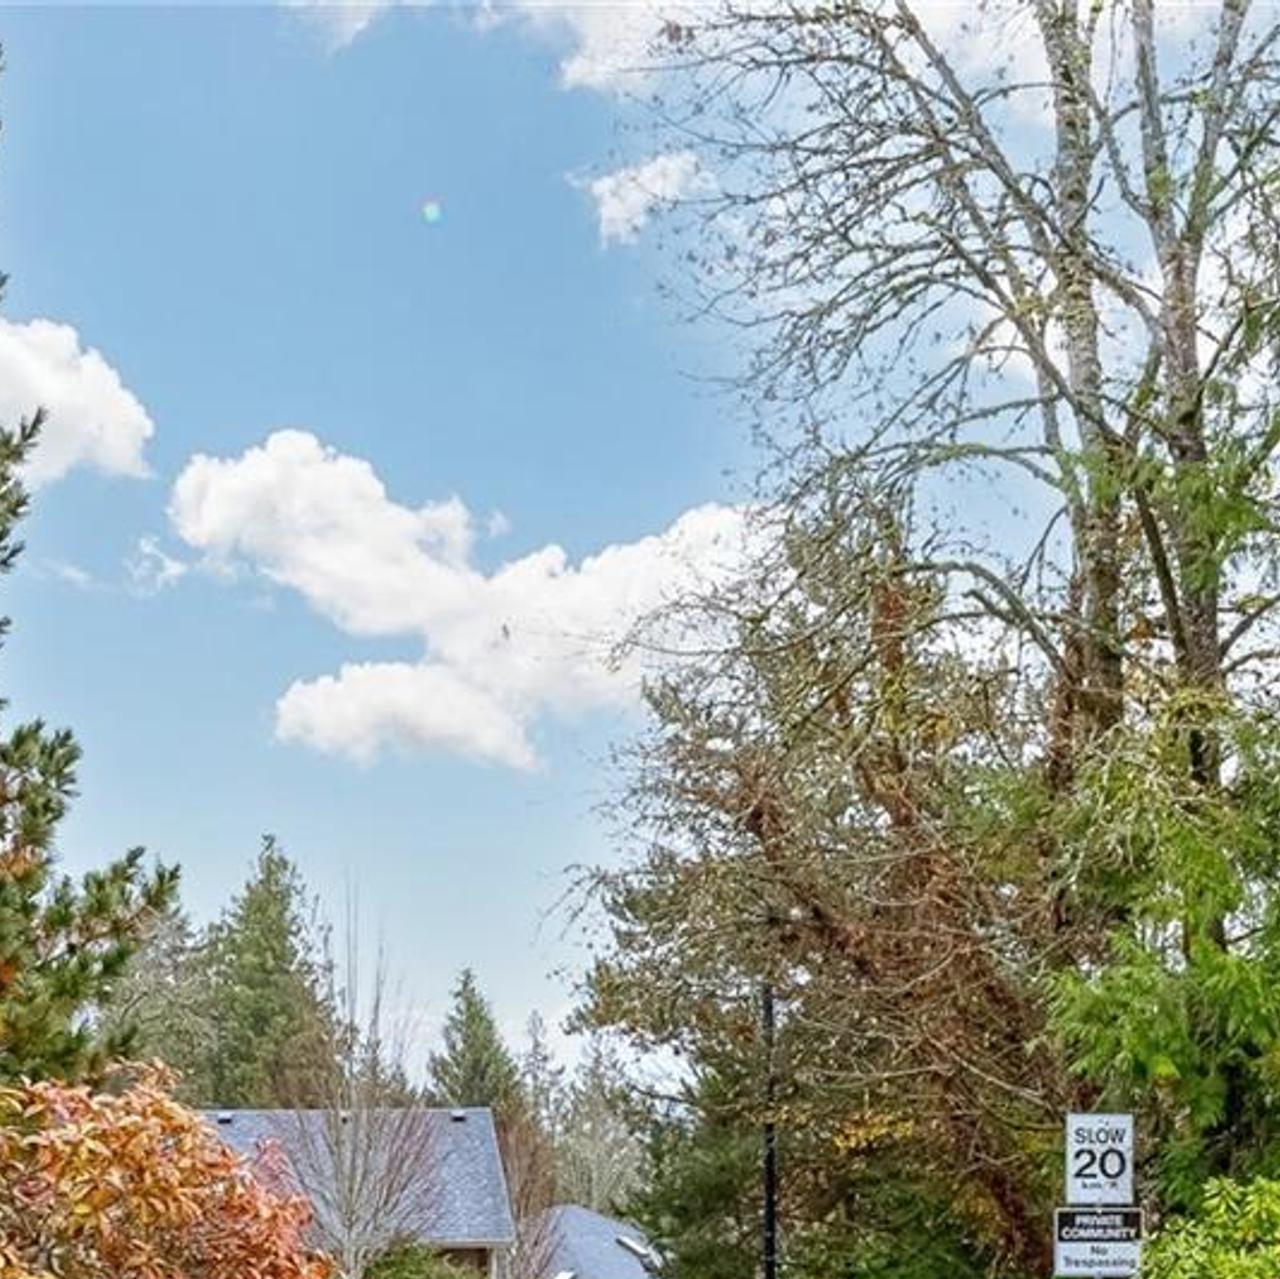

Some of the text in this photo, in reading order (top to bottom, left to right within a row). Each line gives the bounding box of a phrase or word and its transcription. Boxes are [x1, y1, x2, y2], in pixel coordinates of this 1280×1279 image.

[1073, 1128, 1125, 1144] SLOW
[1073, 1149, 1126, 1179] 20
[1090, 1246, 1108, 1256] No
[1063, 1256, 1136, 1269] Trespassing
